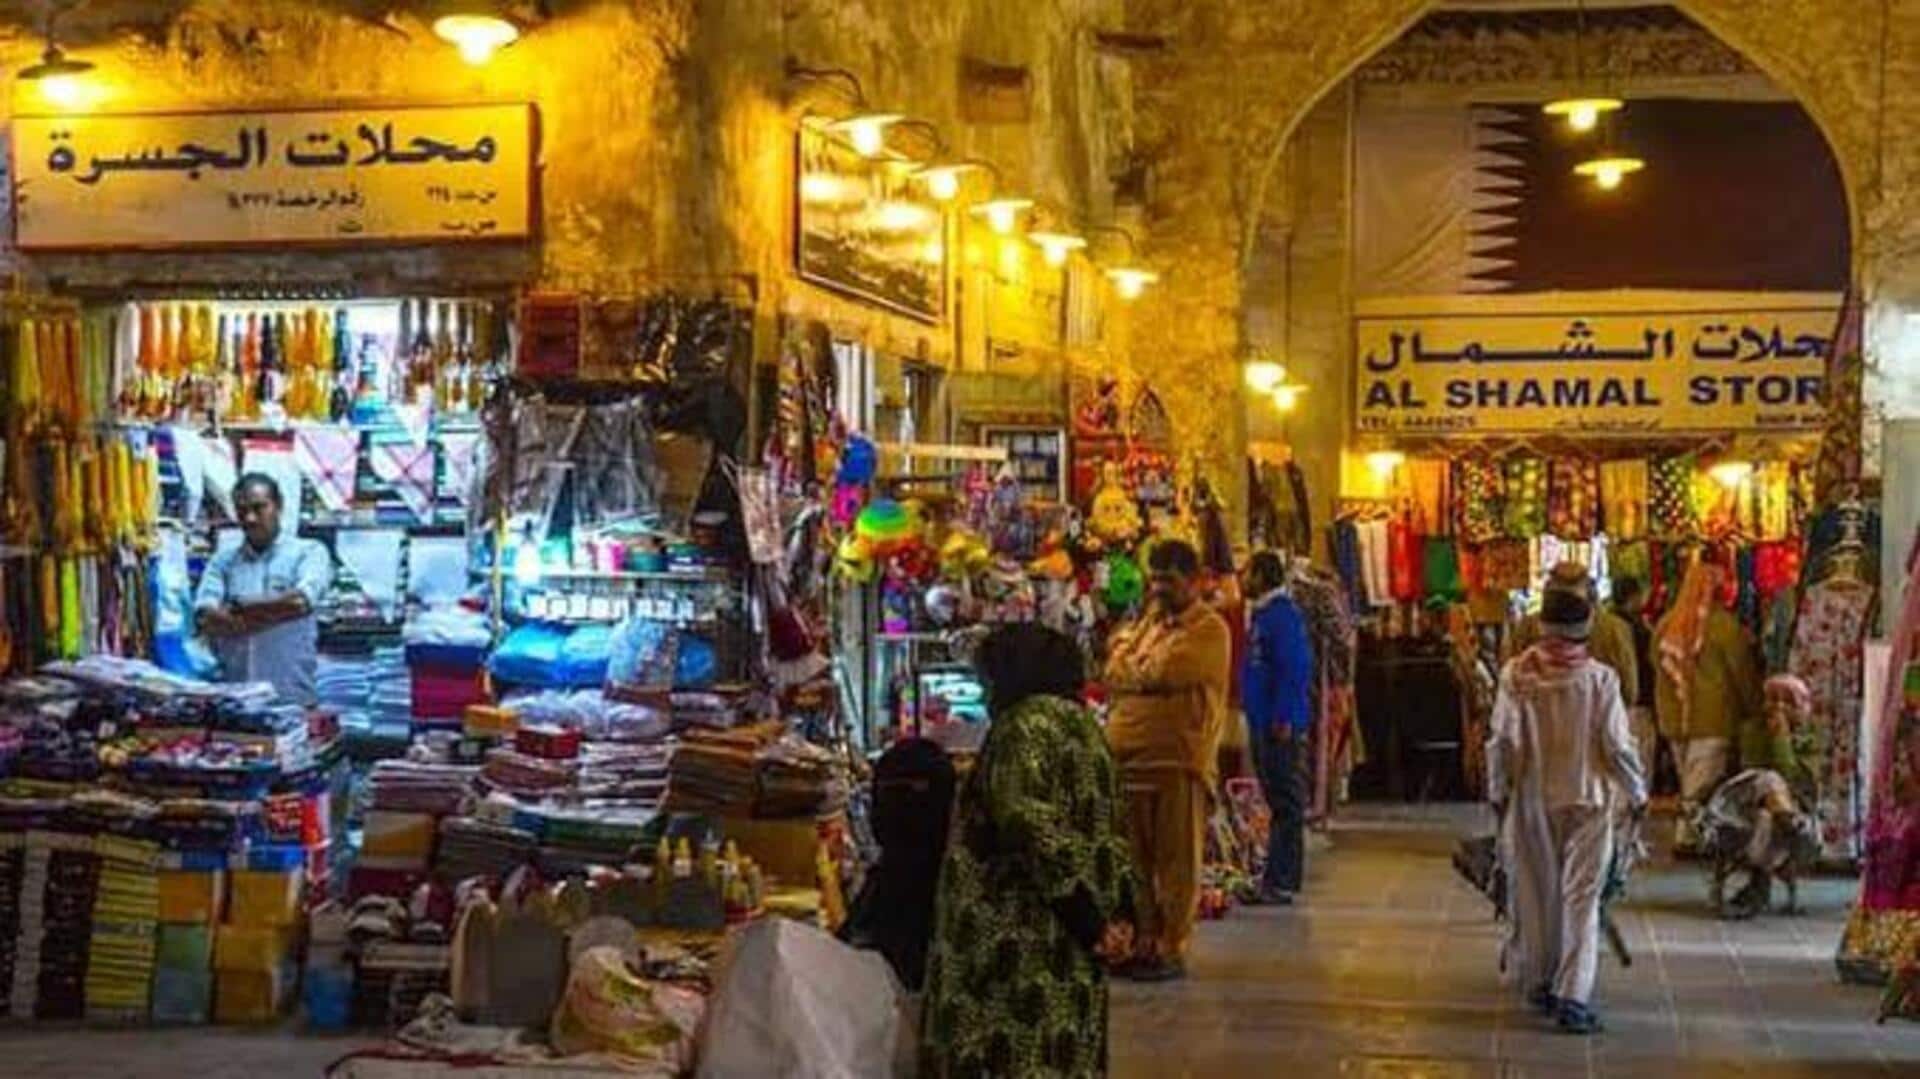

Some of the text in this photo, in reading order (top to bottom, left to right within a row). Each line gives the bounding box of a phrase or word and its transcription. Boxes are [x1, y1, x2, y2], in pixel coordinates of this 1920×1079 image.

[48, 123, 496, 184] محلات الجسرة
[1366, 320, 1831, 372] حلات الشمال
[1364, 379, 1426, 408] AL
[1446, 377, 1661, 407] SHAMAL
